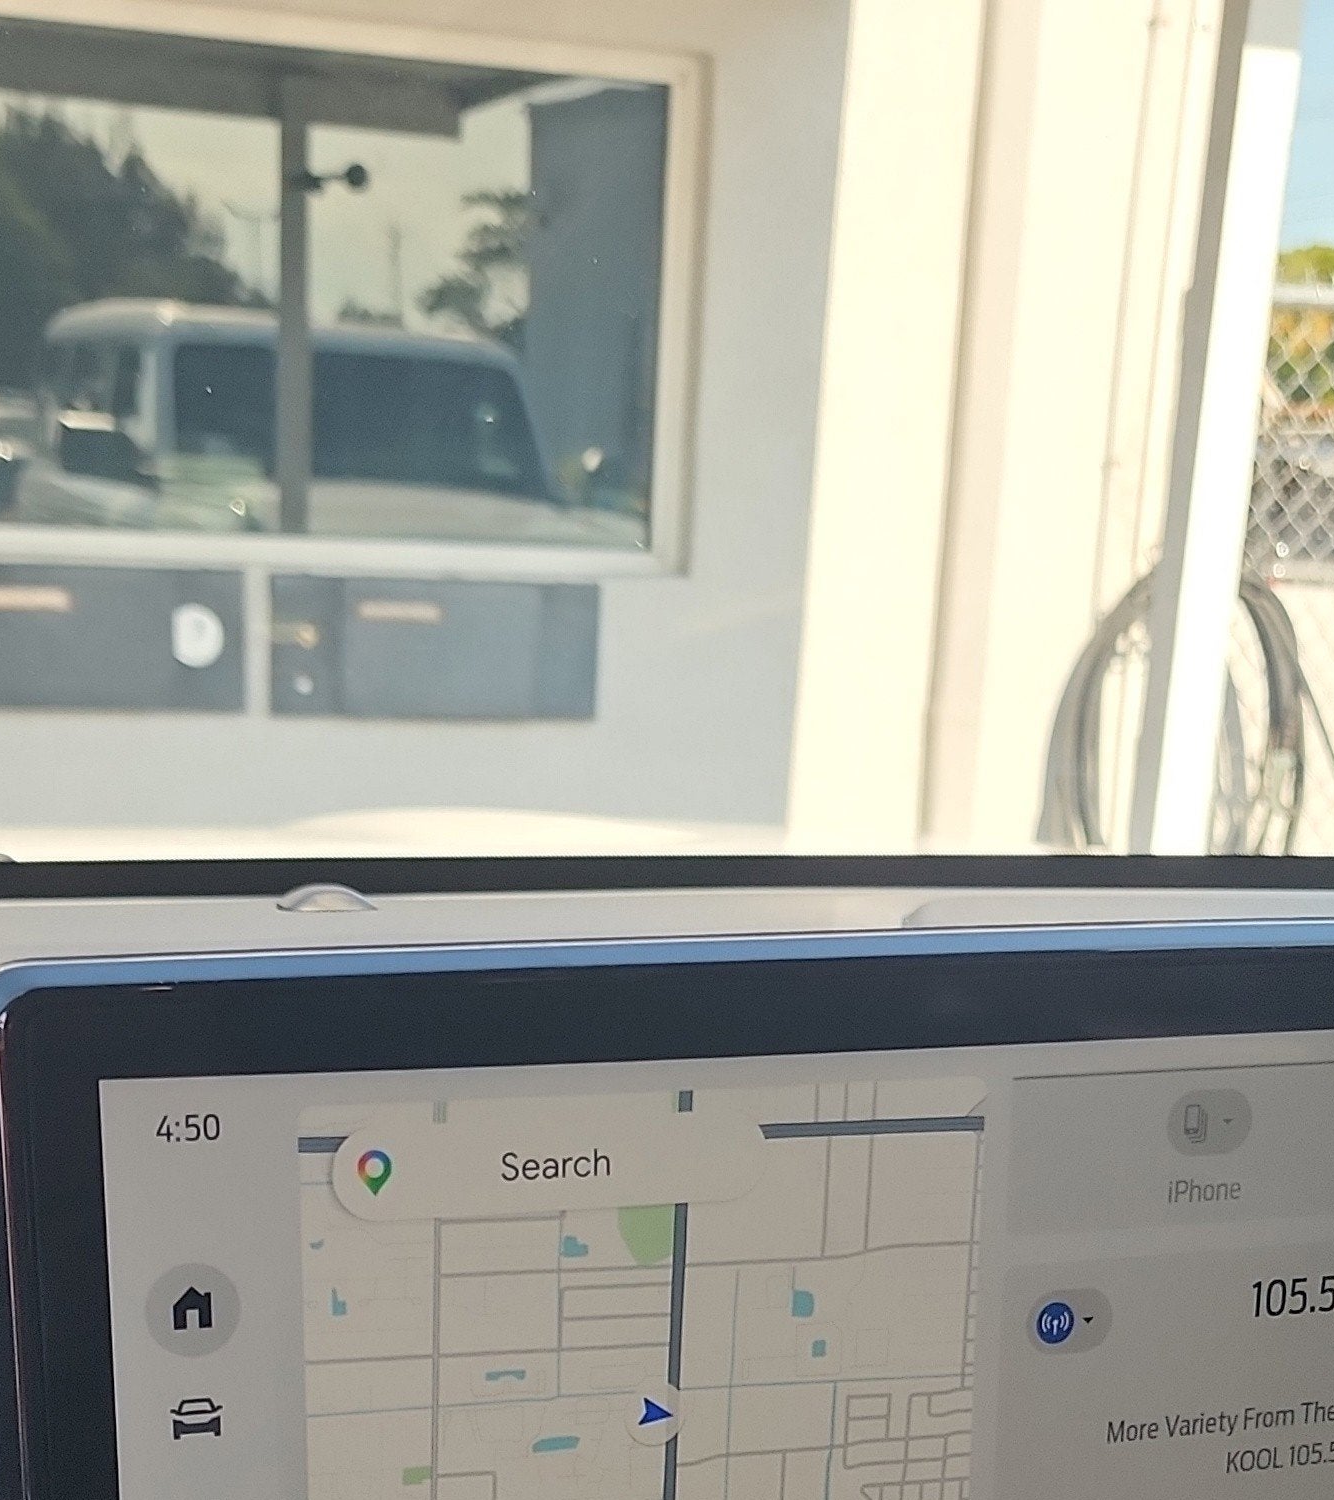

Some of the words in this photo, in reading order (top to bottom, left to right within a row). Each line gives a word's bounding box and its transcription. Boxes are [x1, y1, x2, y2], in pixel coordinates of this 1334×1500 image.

[155, 1112, 221, 1144] 4:50
[500, 1149, 611, 1183] Search
[1167, 1177, 1242, 1203] iPhone
[1106, 1420, 1159, 1444] More
[1165, 1411, 1238, 1437] Variety
[1243, 1405, 1295, 1431] From
[1225, 1447, 1284, 1474] KOOL
